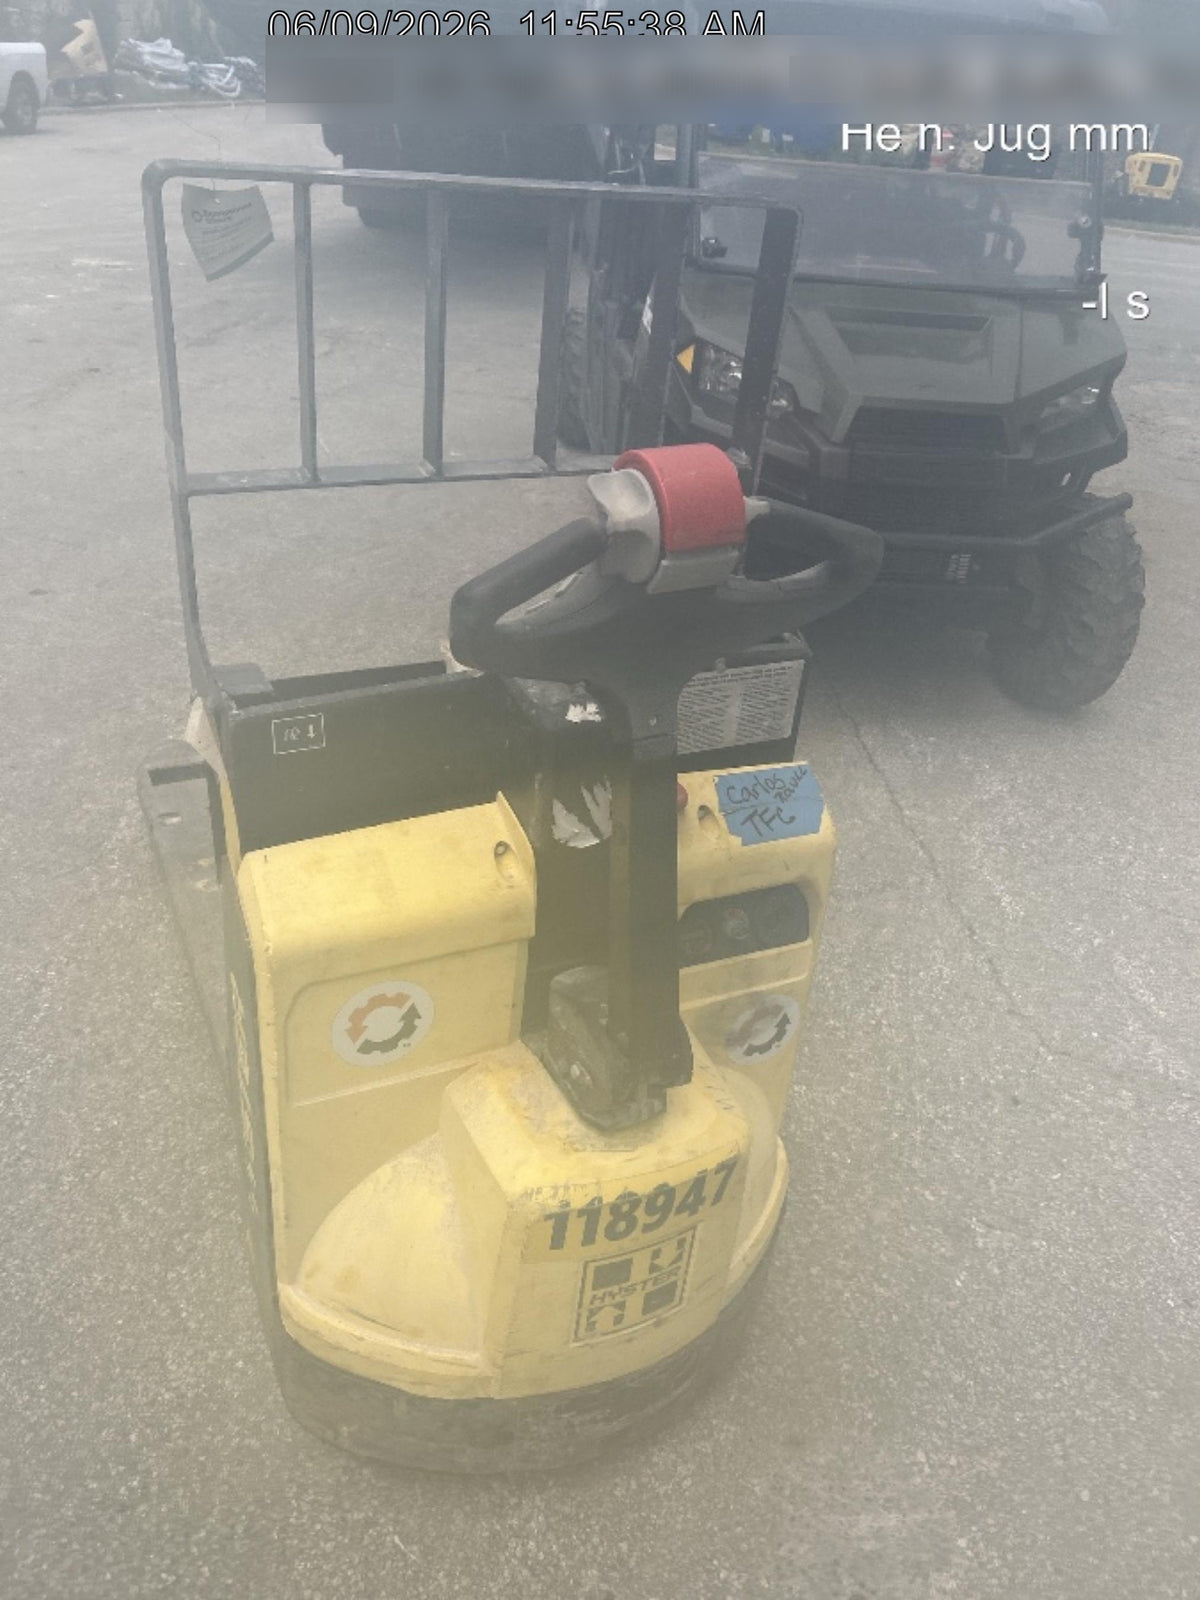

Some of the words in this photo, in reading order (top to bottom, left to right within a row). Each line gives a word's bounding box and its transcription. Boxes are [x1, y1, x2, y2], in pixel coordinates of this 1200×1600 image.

[726, 775, 786, 805] Carlos
[543, 1156, 738, 1251] 118947
[590, 1265, 681, 1306] HYSTER
